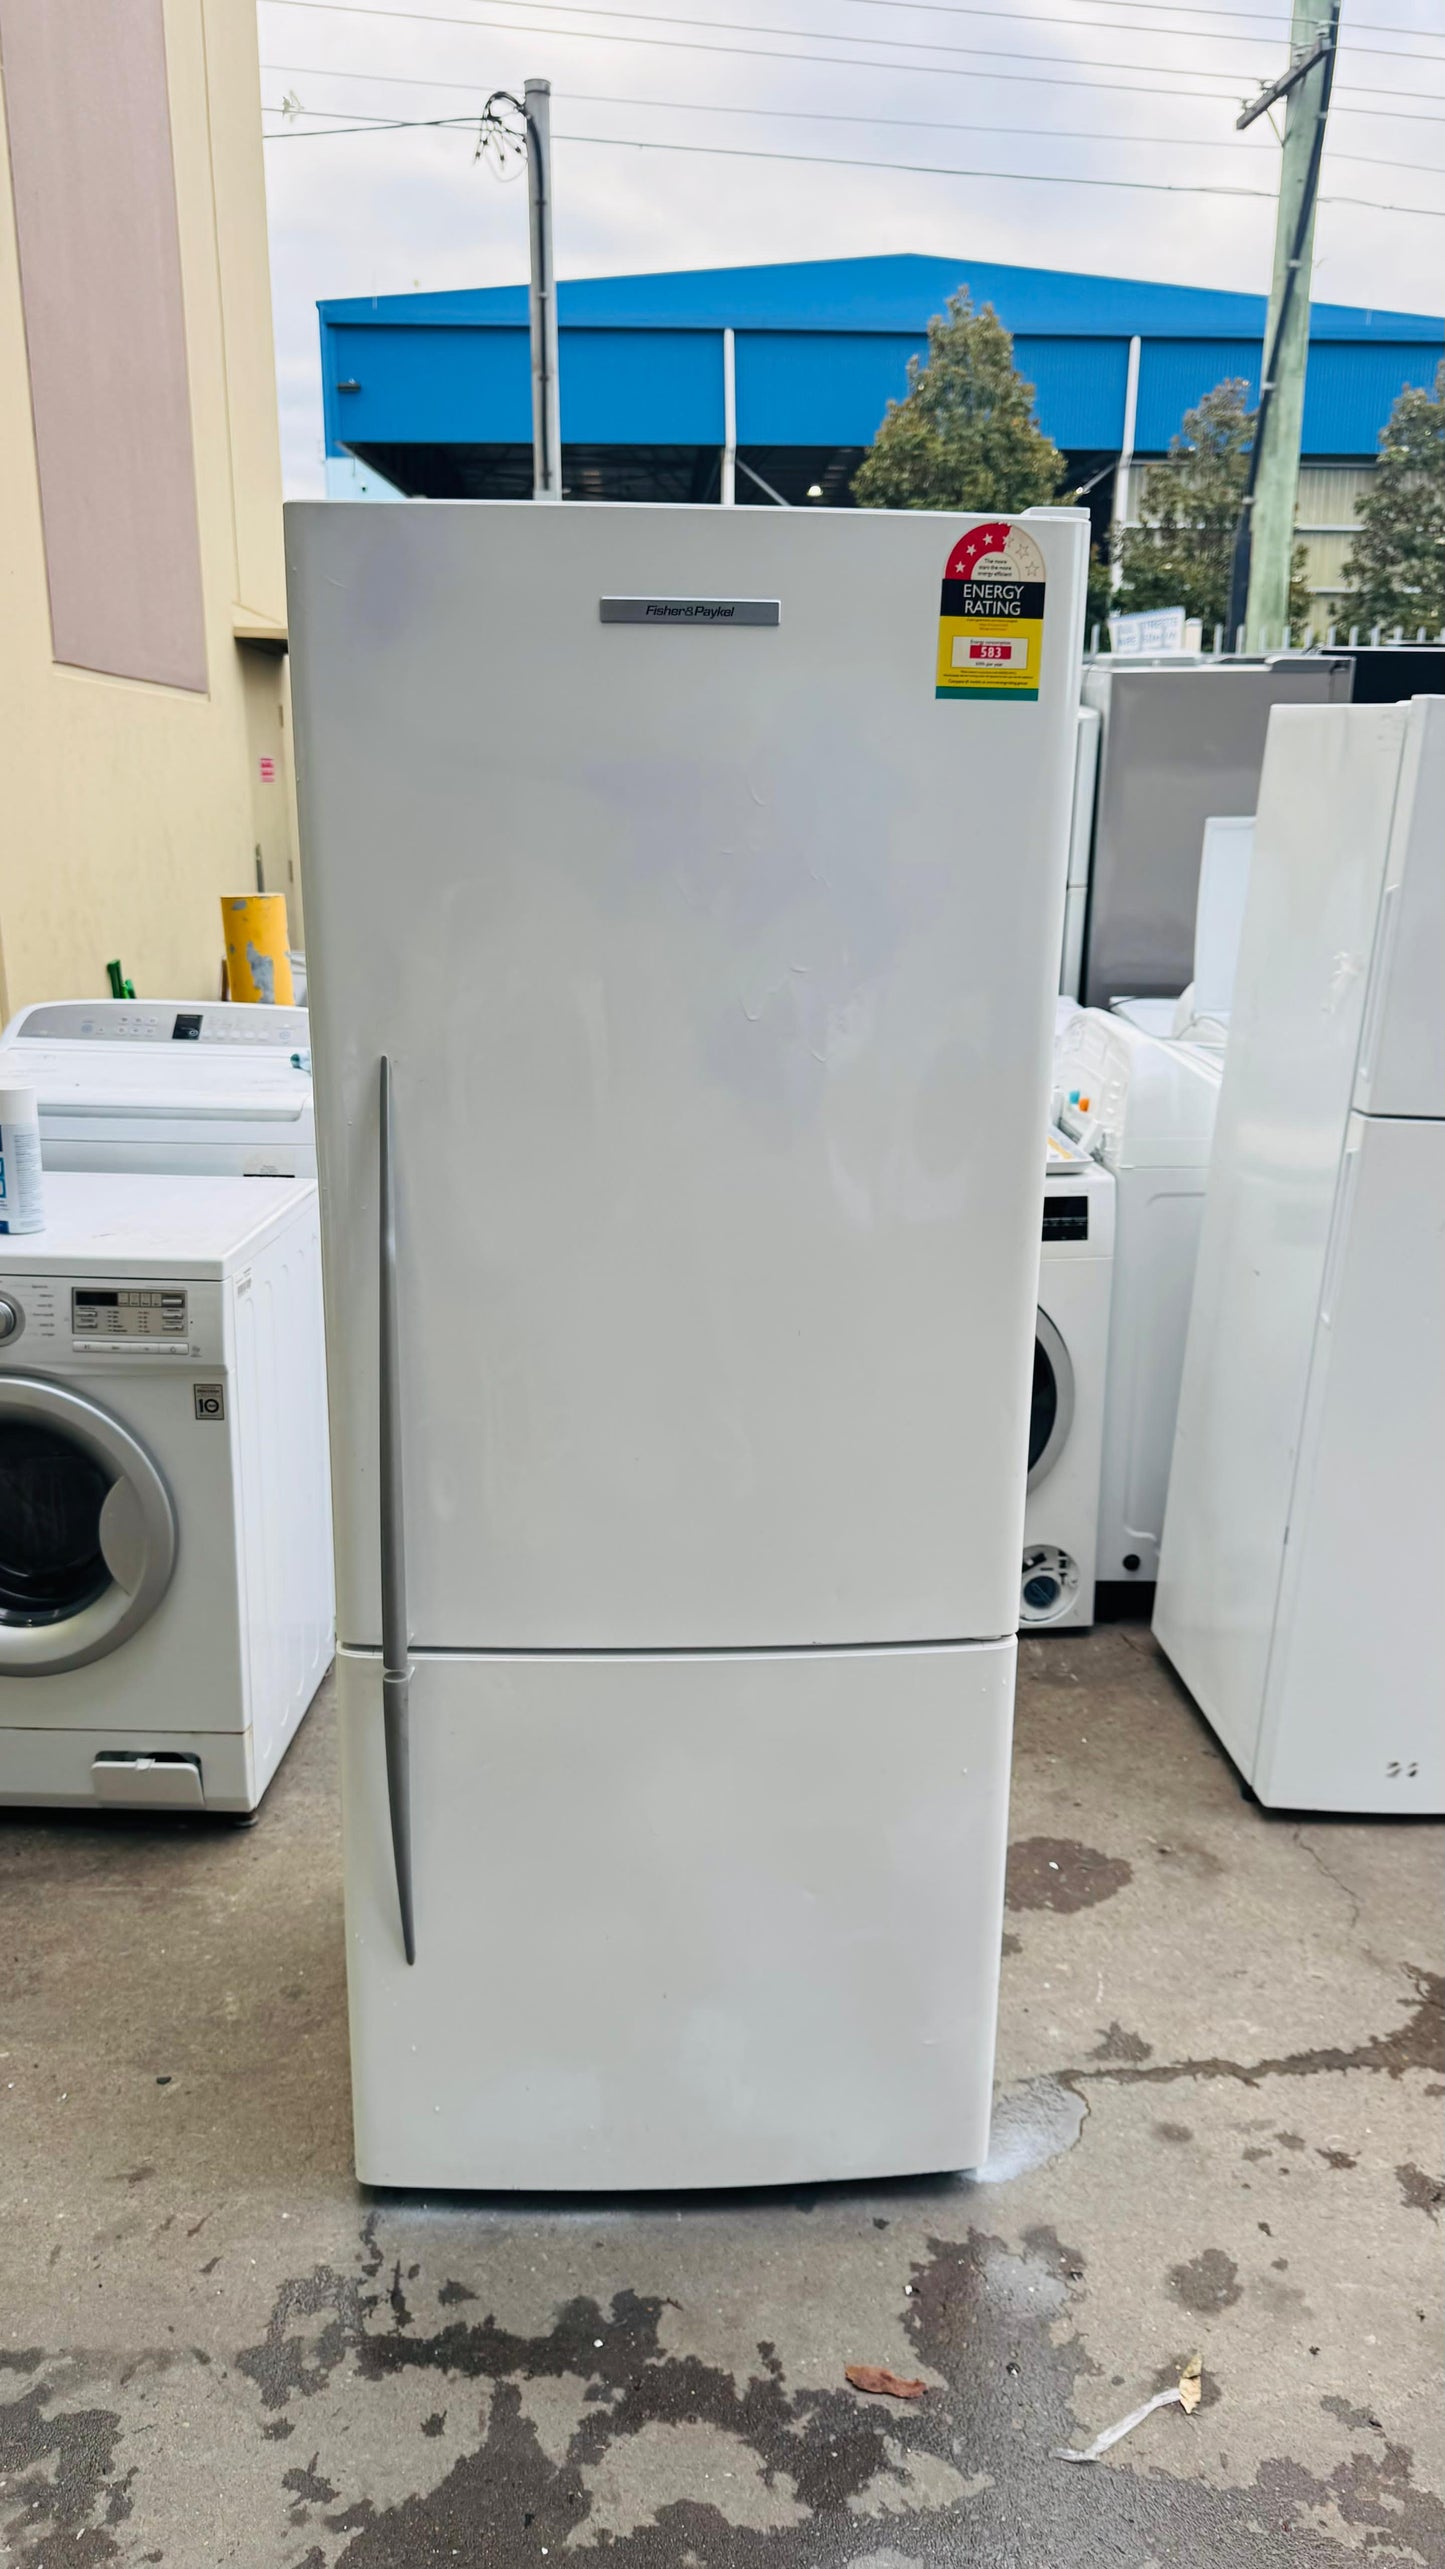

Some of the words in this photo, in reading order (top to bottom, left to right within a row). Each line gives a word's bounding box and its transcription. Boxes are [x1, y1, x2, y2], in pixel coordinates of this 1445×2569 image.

[963, 584, 1024, 599] ENERGY
[646, 605, 735, 619] Fisher&Paykel
[964, 600, 1021, 616] RATING
[980, 646, 1002, 658] 583
